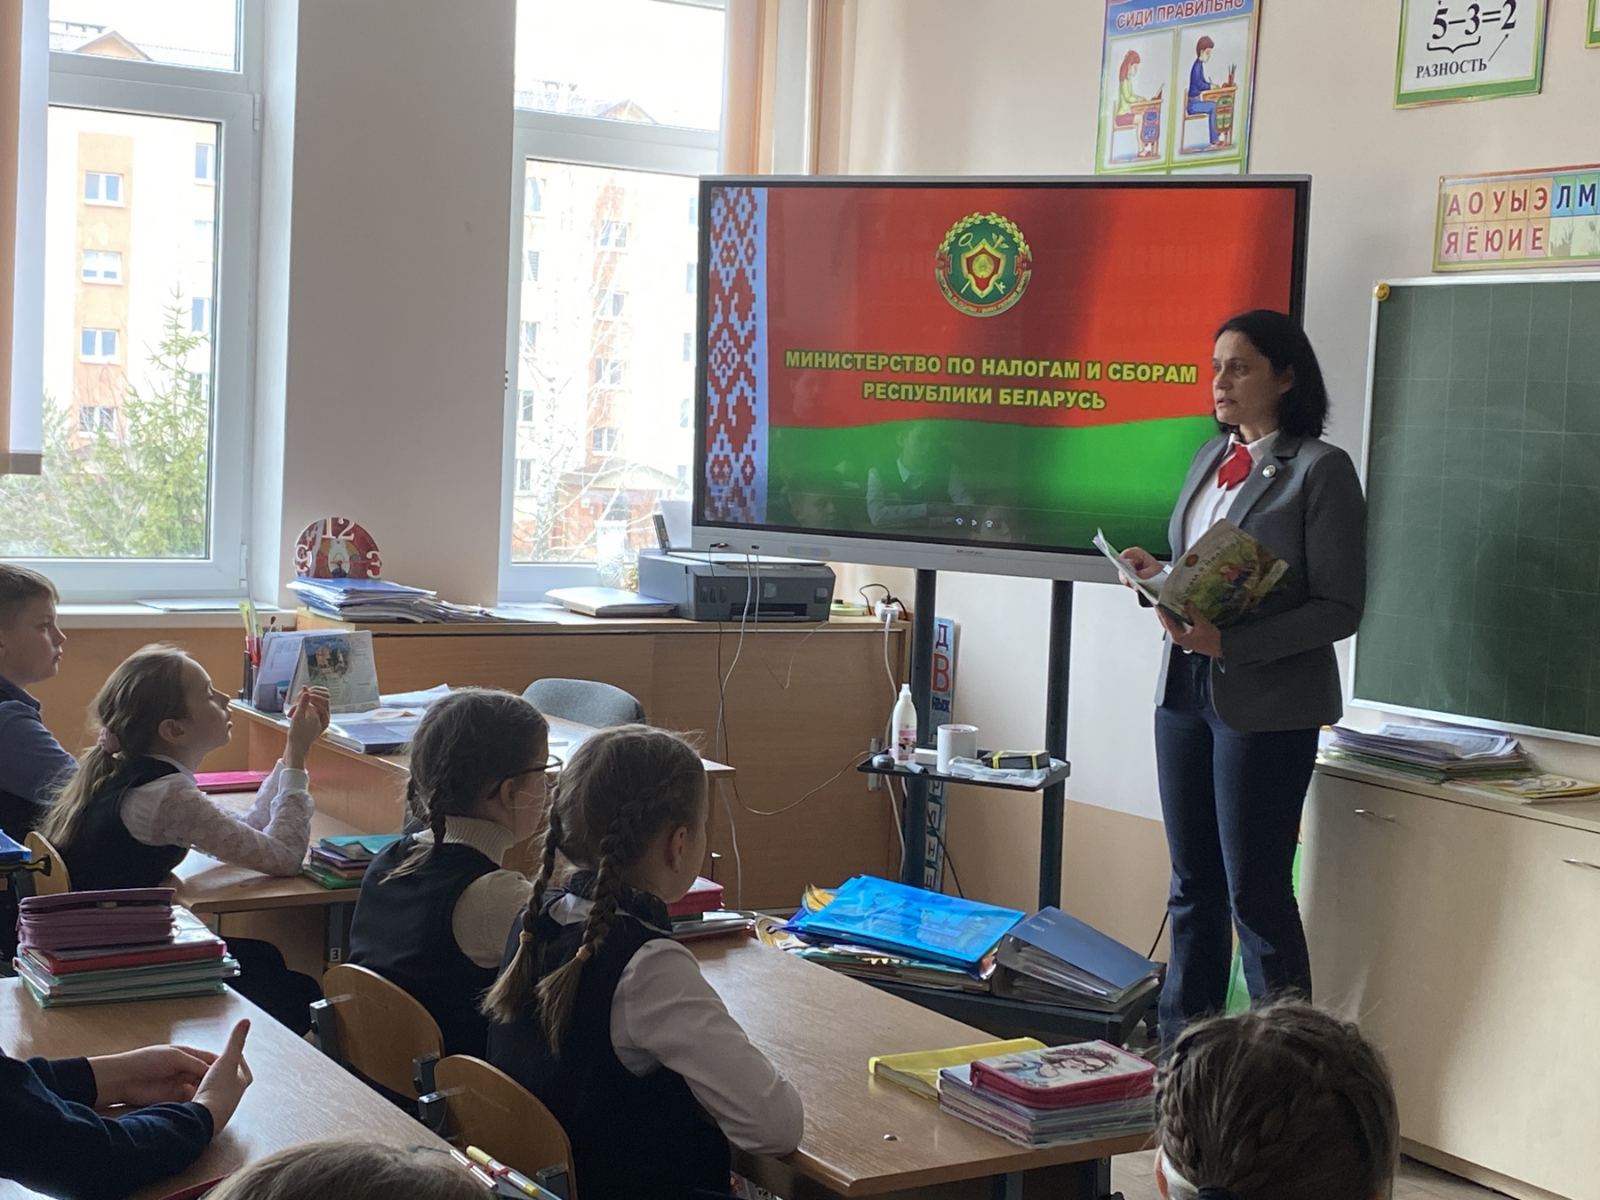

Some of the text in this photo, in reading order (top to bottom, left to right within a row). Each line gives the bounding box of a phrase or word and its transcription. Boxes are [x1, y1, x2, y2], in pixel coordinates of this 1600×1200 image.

[1116, 10, 1153, 28] СИДИ
[1416, 58, 1487, 79] РАЗНОСТЬ
[785, 351, 1198, 383] МИНИСТЕРСТВО ПО НАЛОГАМ И СБОРАМ
[863, 382, 1106, 409] РЕСПУБЛИКИ БЕЛАРУСЬ
[321, 517, 355, 540] 12
[366, 550, 382, 578] 3
